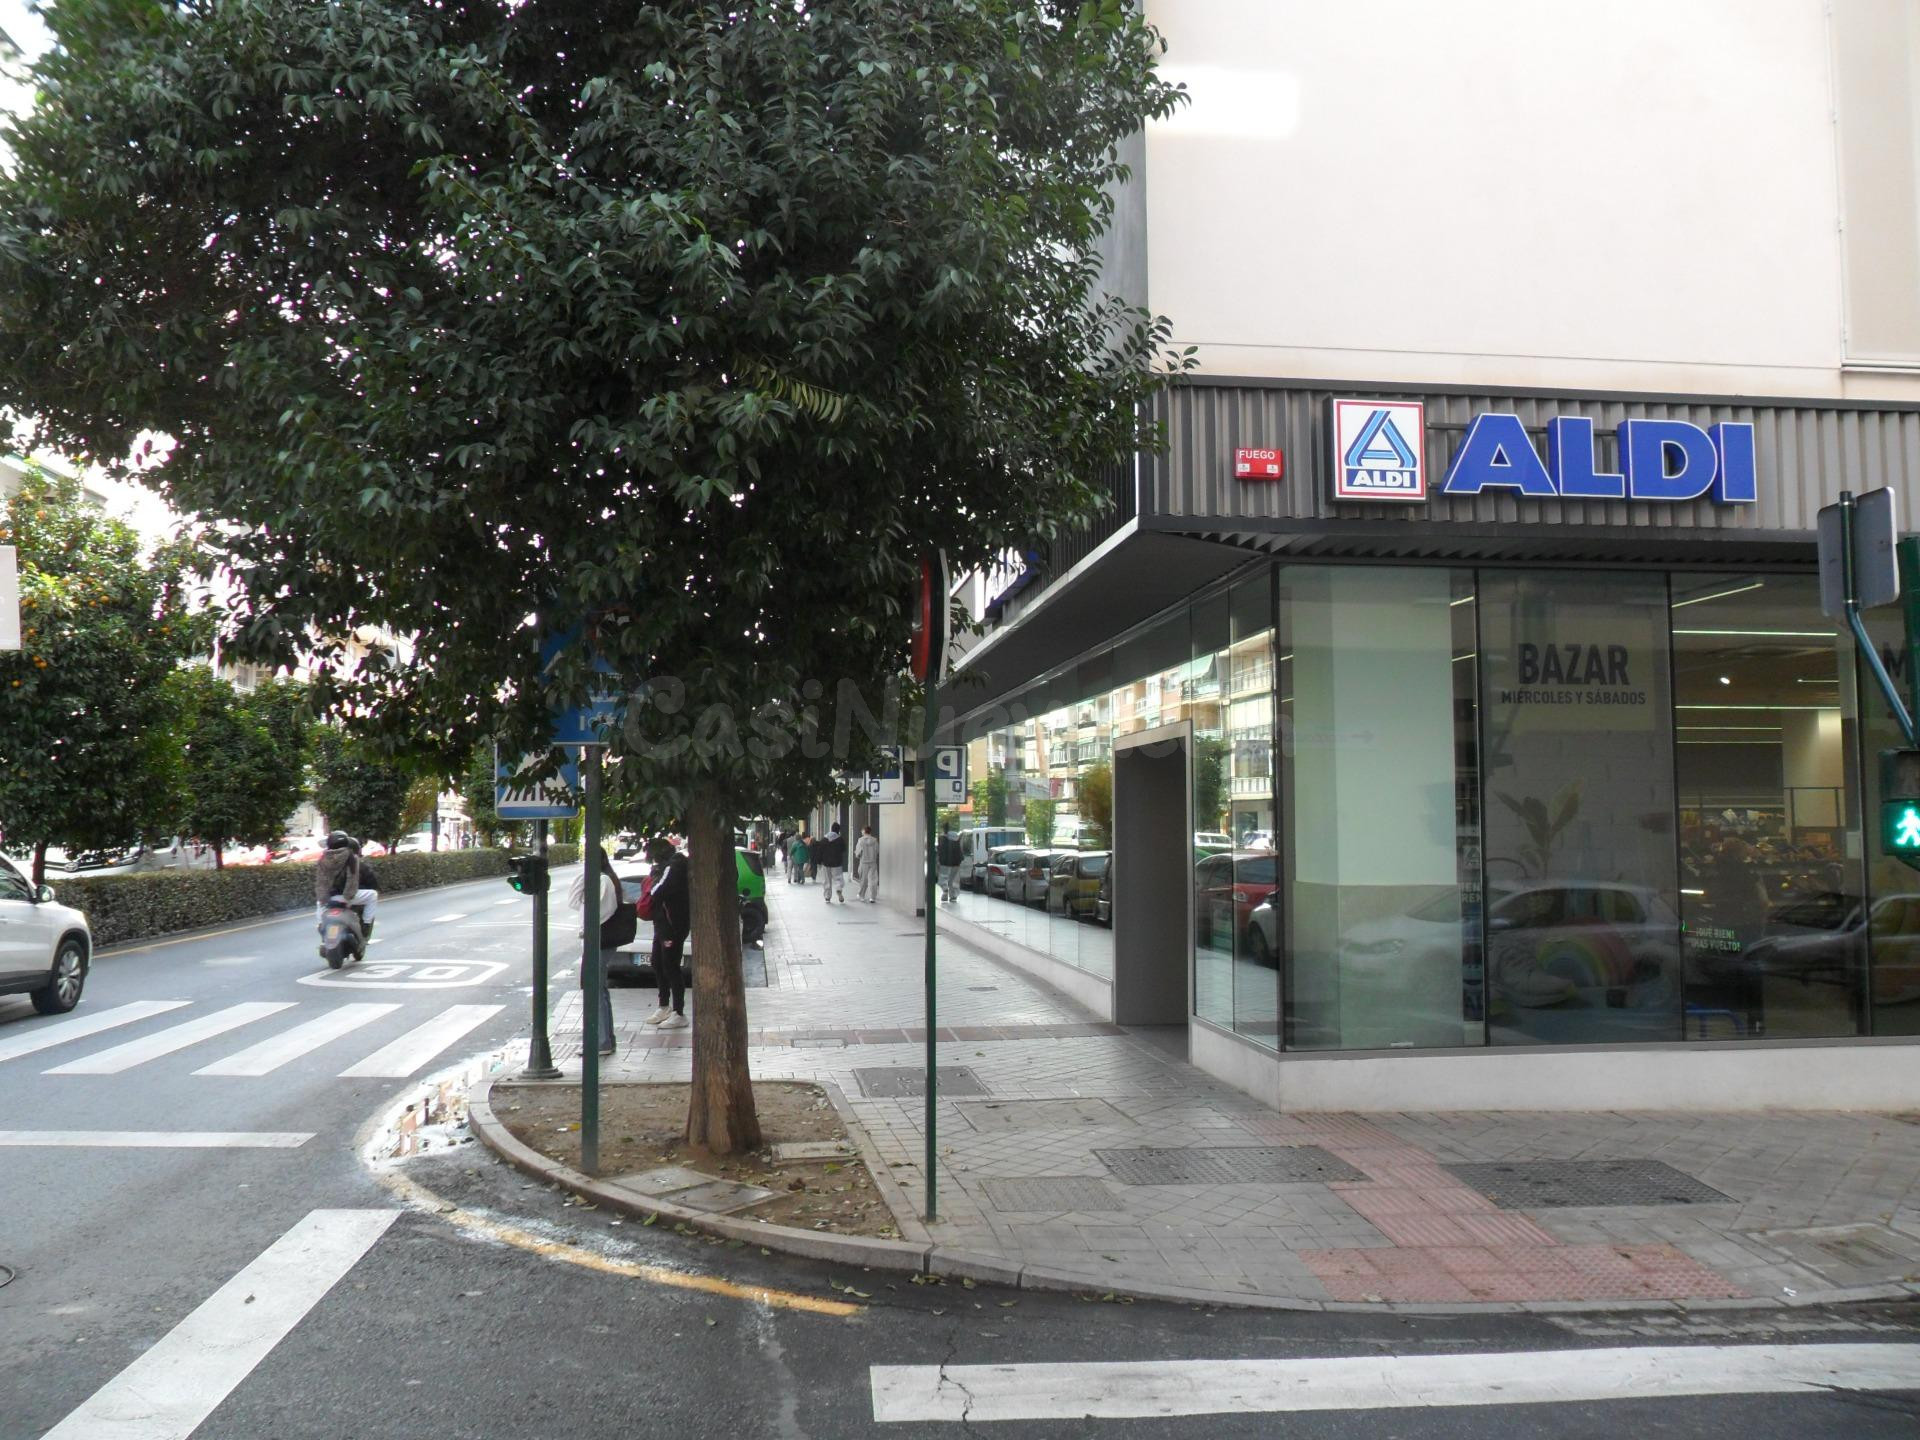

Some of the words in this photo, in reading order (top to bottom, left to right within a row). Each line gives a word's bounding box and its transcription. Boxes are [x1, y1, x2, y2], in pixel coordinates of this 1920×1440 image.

[1239, 450, 1275, 460] FUEGO
[1440, 413, 1757, 503] ALDI
[1353, 471, 1410, 487] ALDI
[1519, 643, 1629, 685] BAZAR
[1501, 688, 1574, 704] MIÉRCOLES
[1574, 691, 1584, 704] Y
[1586, 689, 1646, 704] SÁBADOS
[346, 965, 470, 979] 30
